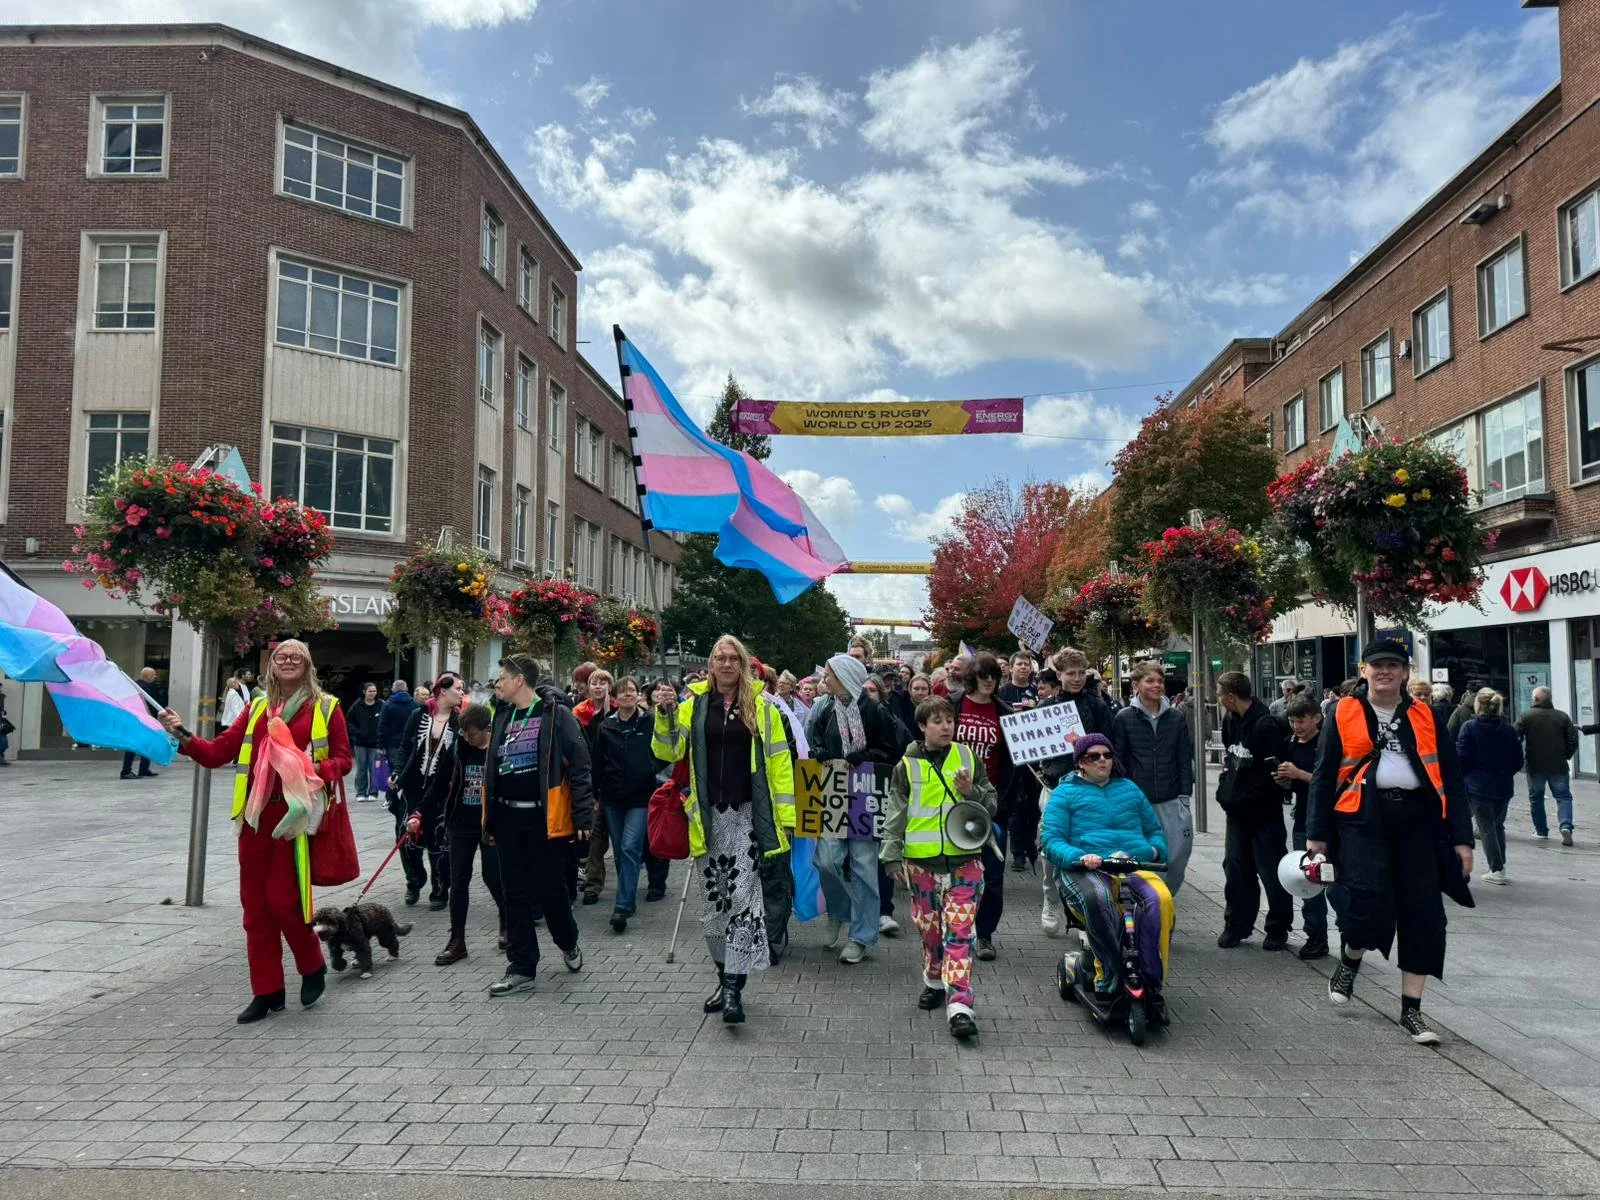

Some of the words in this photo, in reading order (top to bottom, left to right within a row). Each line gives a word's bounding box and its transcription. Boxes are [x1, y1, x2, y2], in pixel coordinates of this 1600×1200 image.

[806, 409, 876, 419] WOMEN'S
[880, 409, 930, 418] RUGBY
[975, 412, 1019, 420] ENERGY
[803, 420, 857, 429] WORLD
[861, 420, 891, 429] CUP
[894, 420, 933, 429] 2025
[1549, 570, 1590, 594] HSBC
[1020, 711, 1038, 724] MY
[1042, 703, 1073, 719] NON
[1010, 724, 1061, 743] BINARY
[1012, 742, 1067, 760] FINERY
[801, 766, 847, 792] WE
[809, 794, 857, 810] NOT
